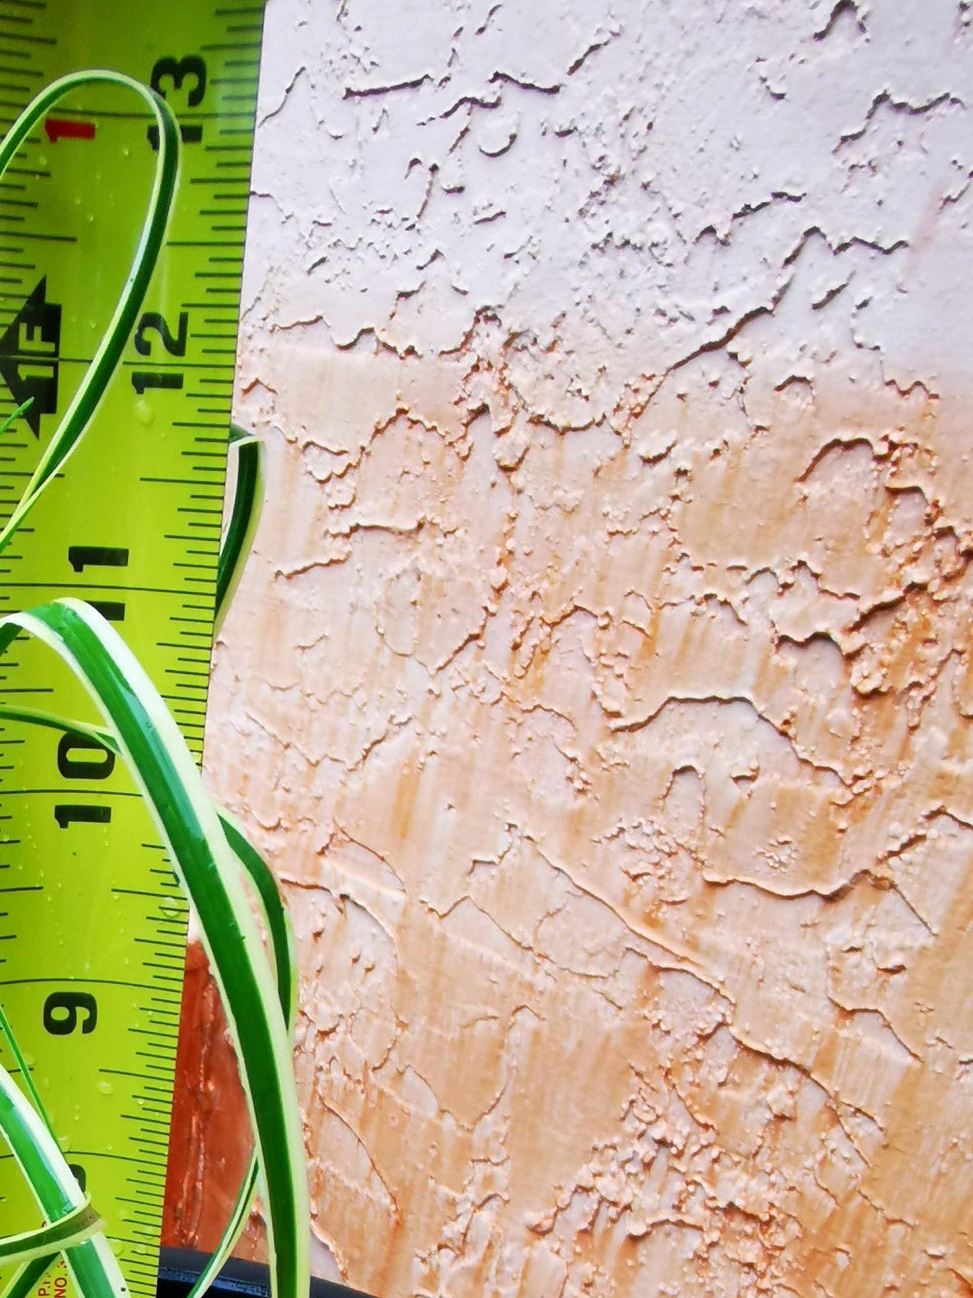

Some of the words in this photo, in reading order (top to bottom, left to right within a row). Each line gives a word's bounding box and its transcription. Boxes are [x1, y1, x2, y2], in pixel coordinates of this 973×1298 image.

[44, 119, 95, 143] 1
[17, 322, 54, 383] 1F
[132, 312, 189, 394] 12
[54, 731, 116, 829] 10
[43, 991, 98, 1035] 9
